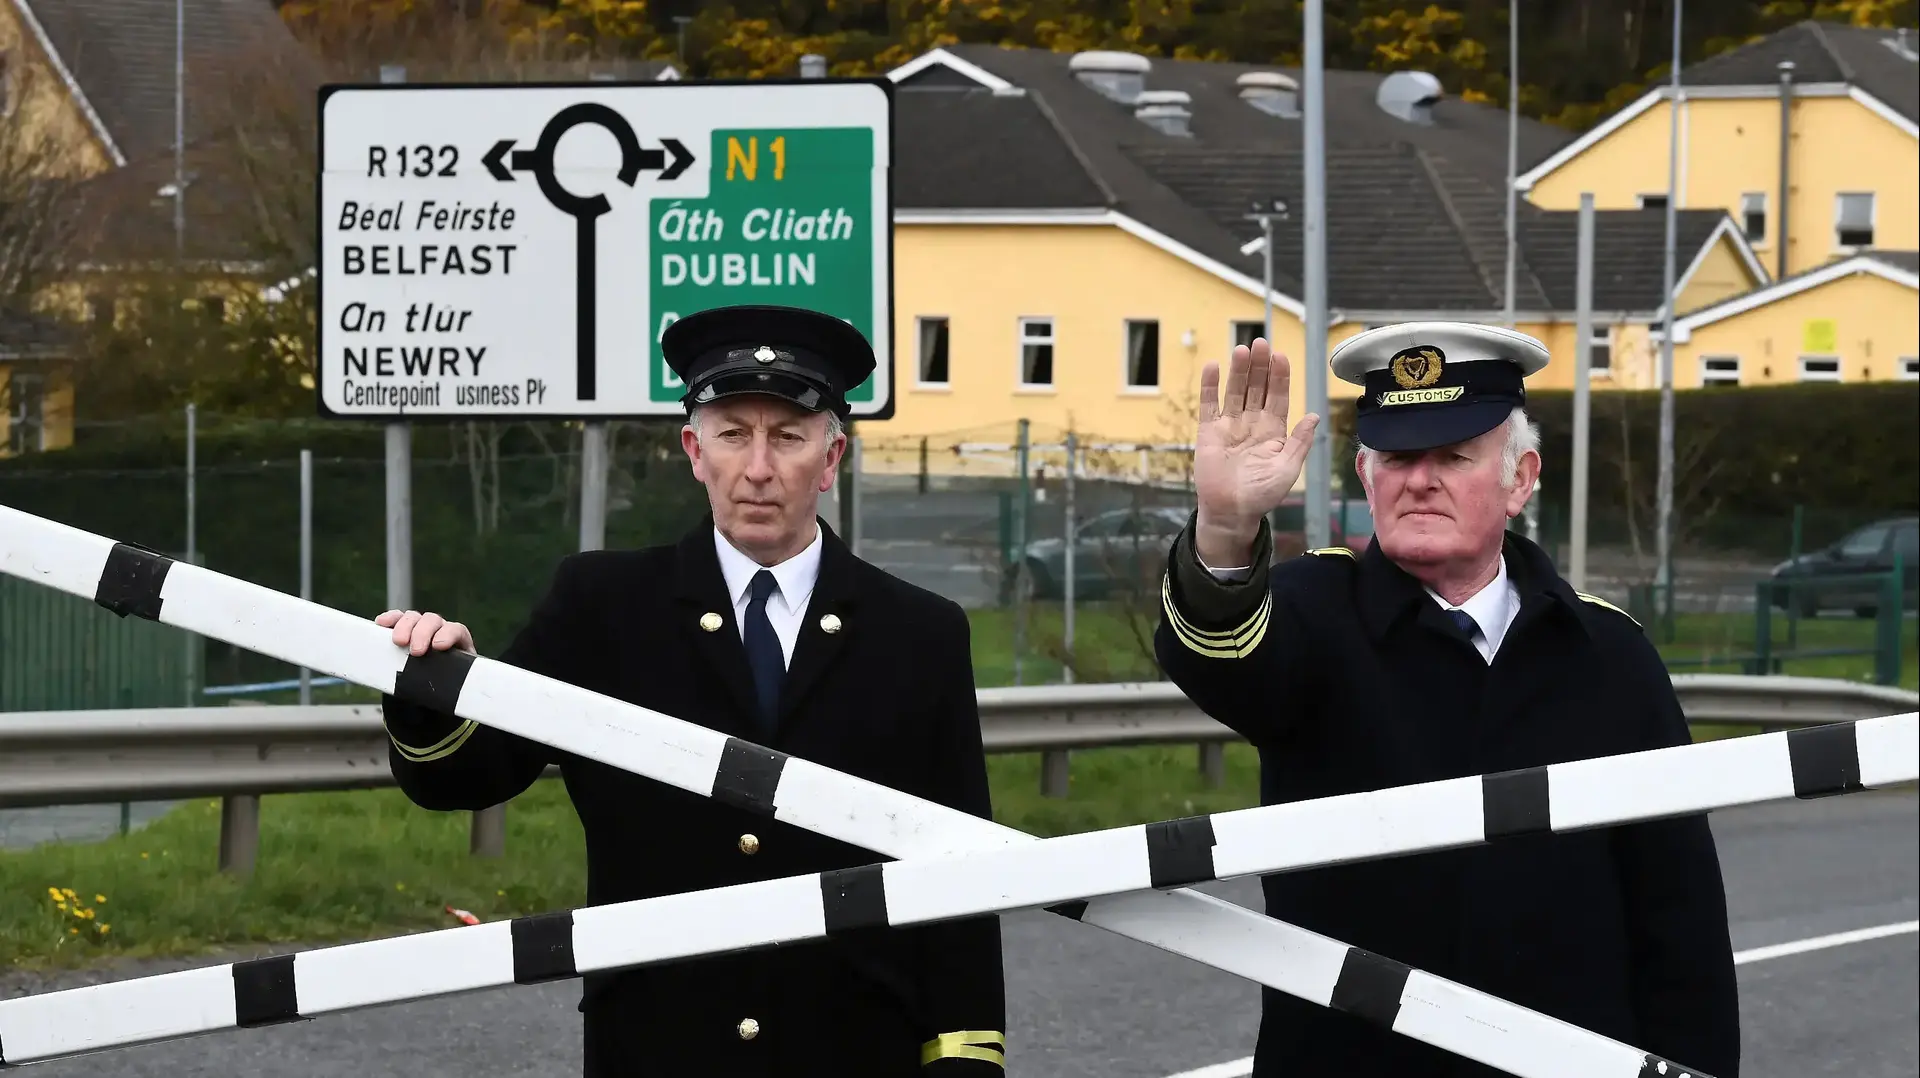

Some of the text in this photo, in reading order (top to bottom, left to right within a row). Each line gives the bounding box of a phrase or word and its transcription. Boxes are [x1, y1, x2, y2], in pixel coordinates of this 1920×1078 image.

[416, 200, 515, 231] Feirste
[658, 201, 853, 242] Áth Cliath
[344, 245, 517, 275] BELFAST
[662, 253, 816, 286] DUBLIN
[340, 302, 386, 332] An
[343, 347, 487, 376] NEWRY
[344, 379, 440, 409] Centrepoint
[1387, 389, 1453, 403] CUSTOMS
